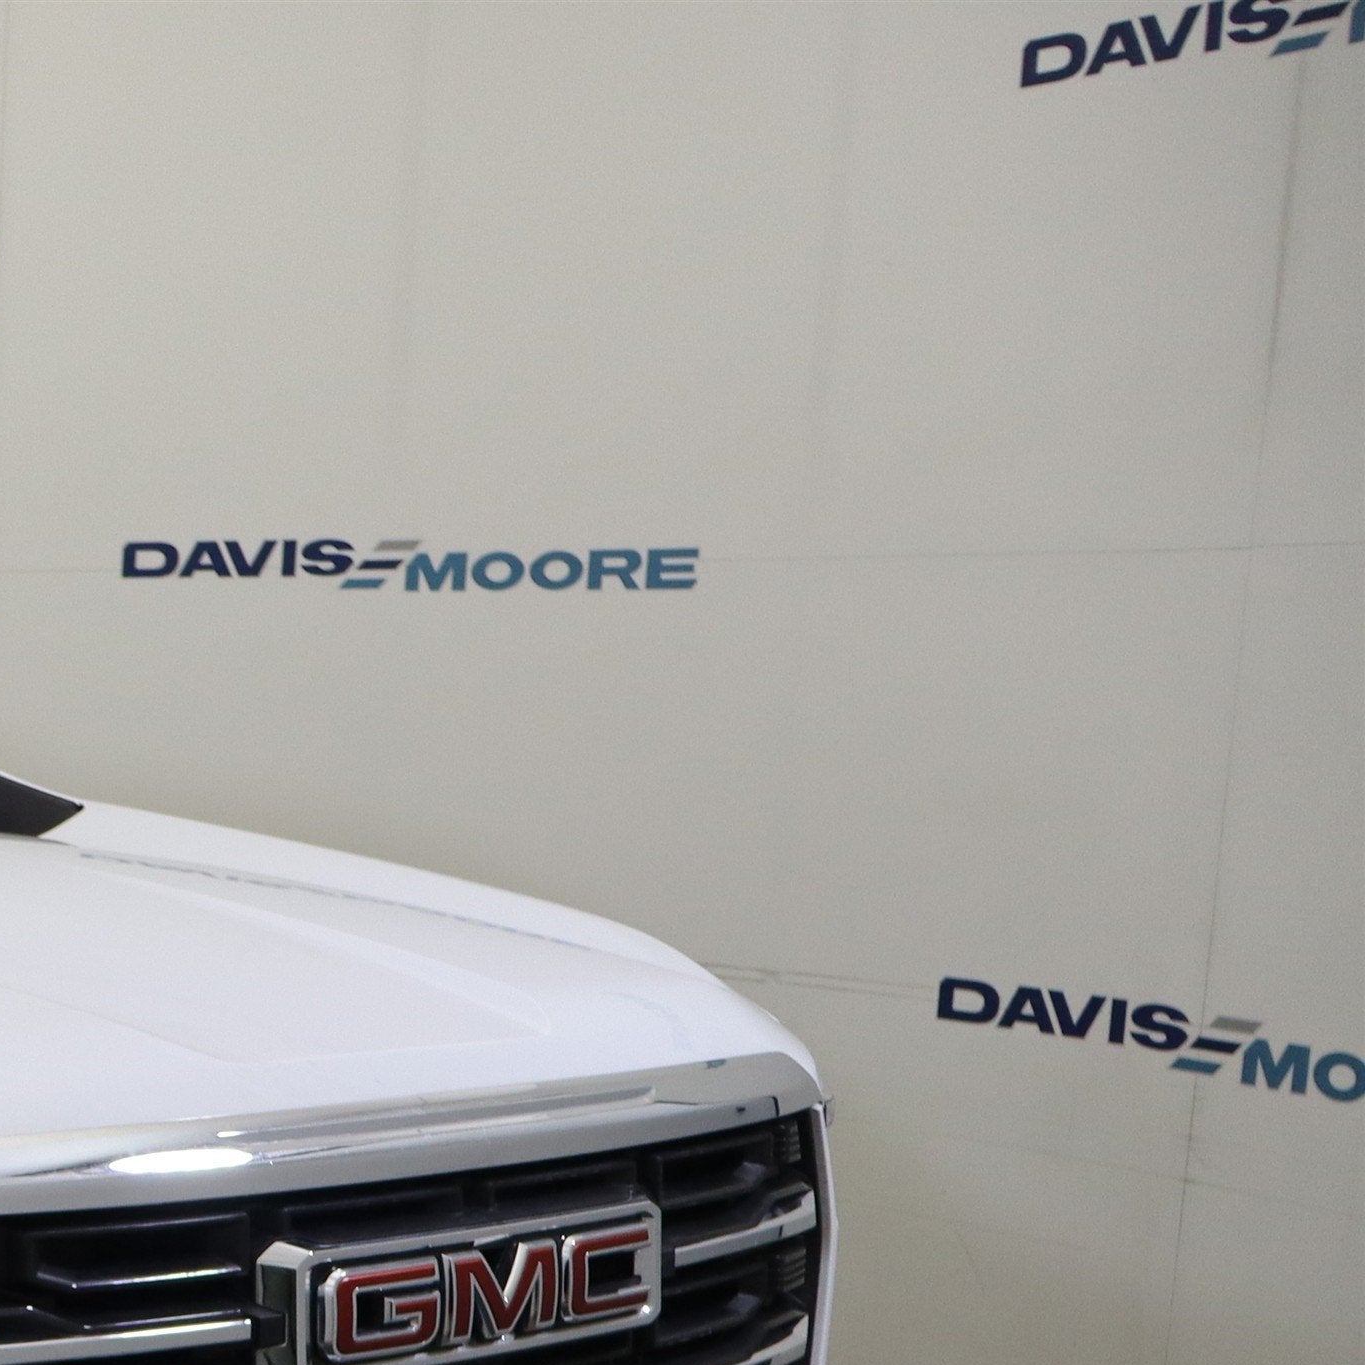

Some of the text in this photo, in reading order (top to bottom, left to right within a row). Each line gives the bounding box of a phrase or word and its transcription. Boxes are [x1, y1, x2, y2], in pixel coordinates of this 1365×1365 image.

[1021, 0, 1290, 88] DAVIS
[121, 539, 699, 591] DAVIS MOORE
[937, 976, 1189, 1051] DAVIS
[318, 1220, 652, 1363] GMC
